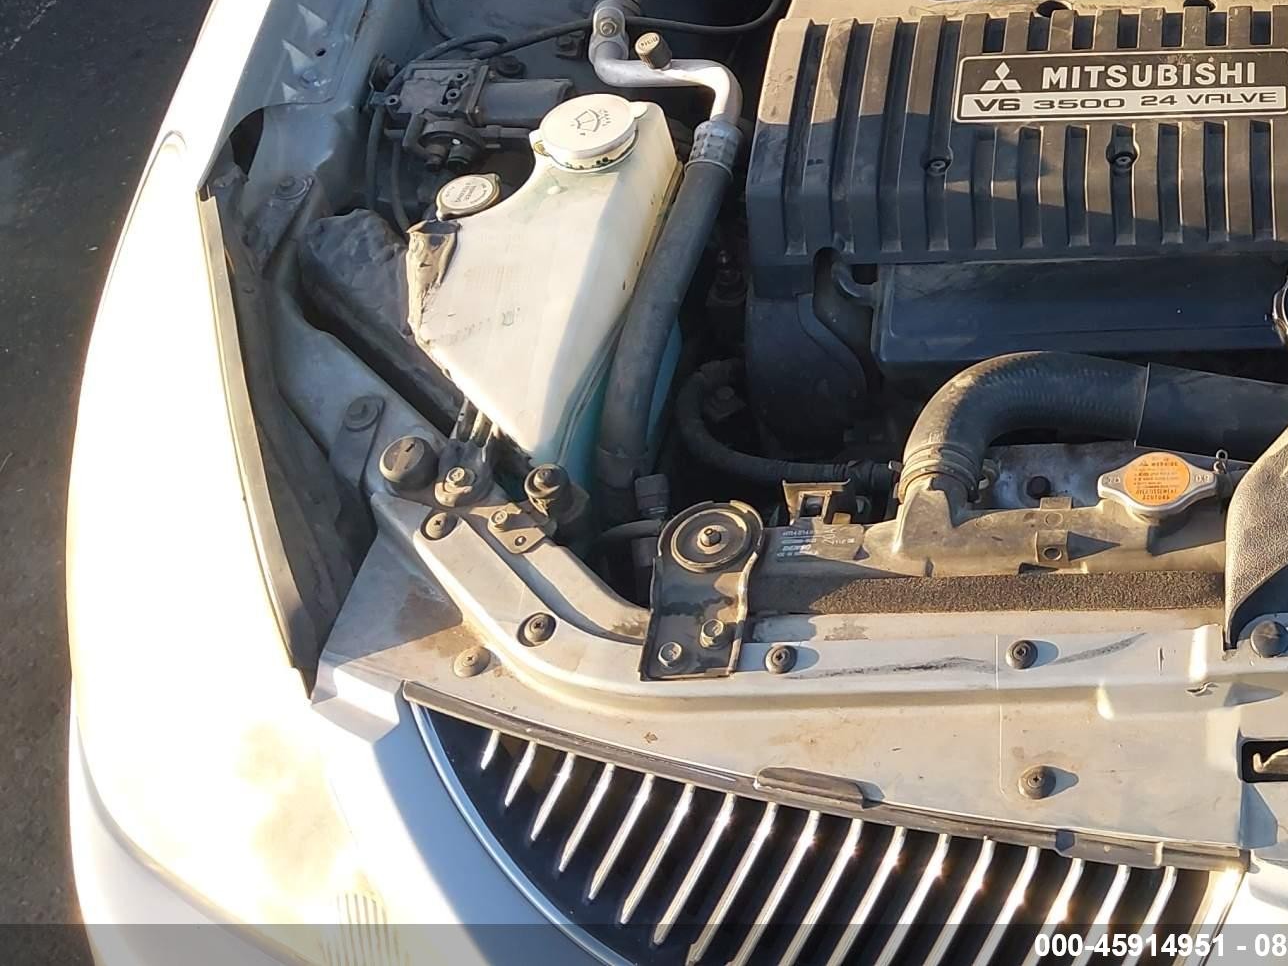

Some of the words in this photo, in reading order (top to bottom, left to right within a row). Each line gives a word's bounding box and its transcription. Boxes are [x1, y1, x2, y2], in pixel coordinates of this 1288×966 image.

[1042, 62, 1256, 89] MITSUBISHI
[973, 98, 1021, 112] V6
[1033, 98, 1126, 110] 3500
[1140, 95, 1178, 107] 24
[1186, 91, 1278, 105] VALVE
